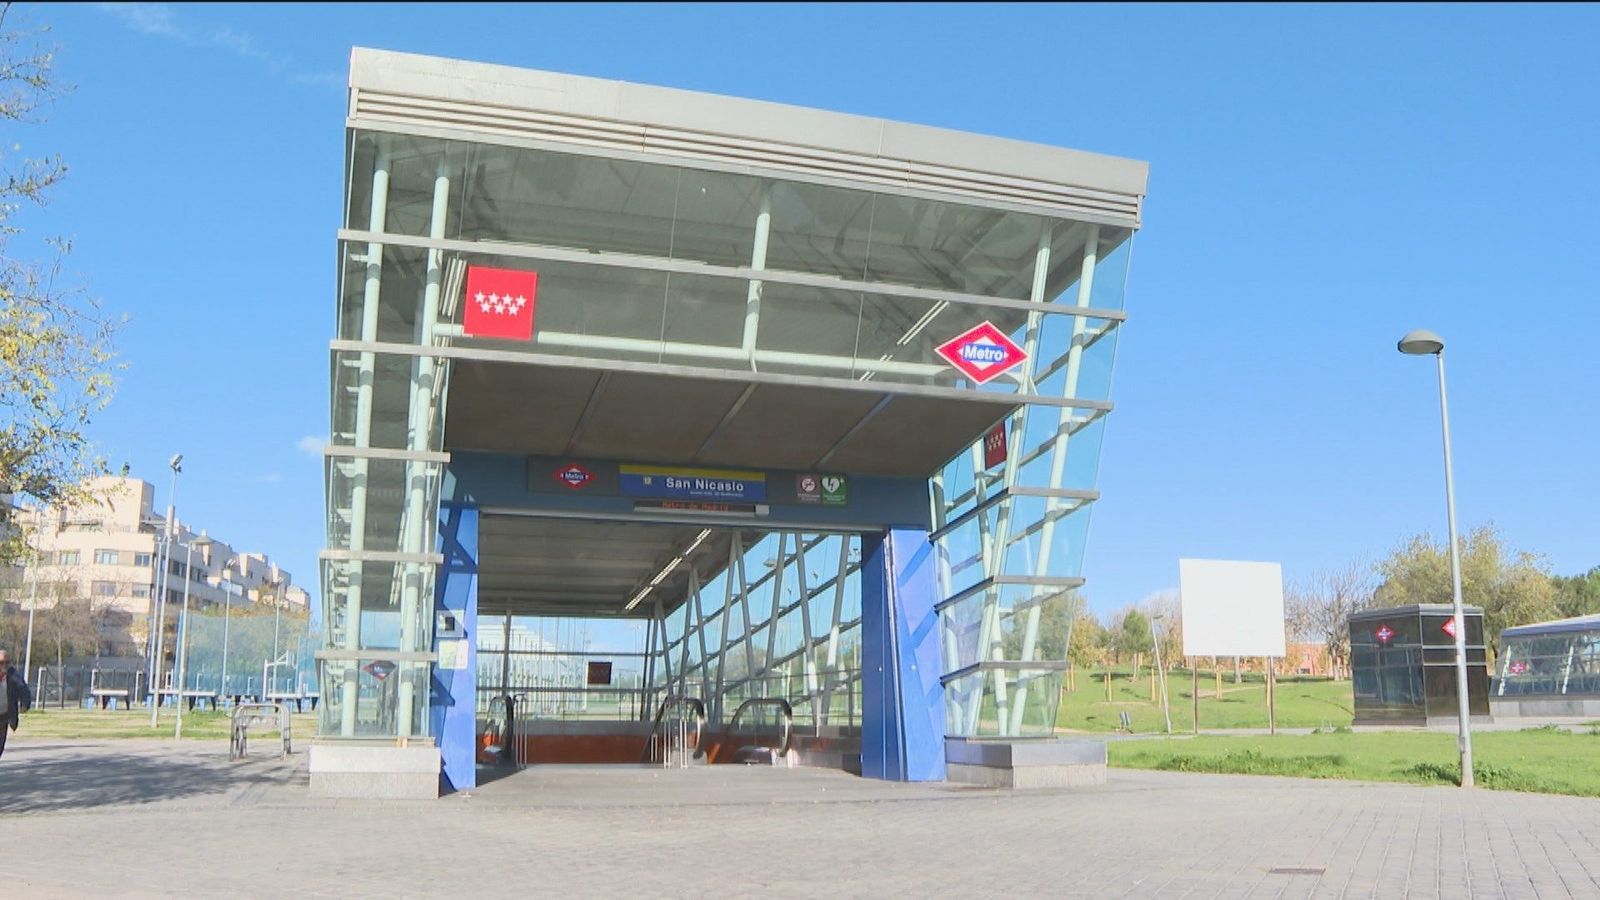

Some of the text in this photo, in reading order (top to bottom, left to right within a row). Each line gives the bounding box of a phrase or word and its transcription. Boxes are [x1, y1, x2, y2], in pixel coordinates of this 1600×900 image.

[964, 344, 1004, 361] Metro
[564, 471, 584, 480] Metro
[666, 477, 691, 489] San
[695, 478, 744, 492] Nicasio
